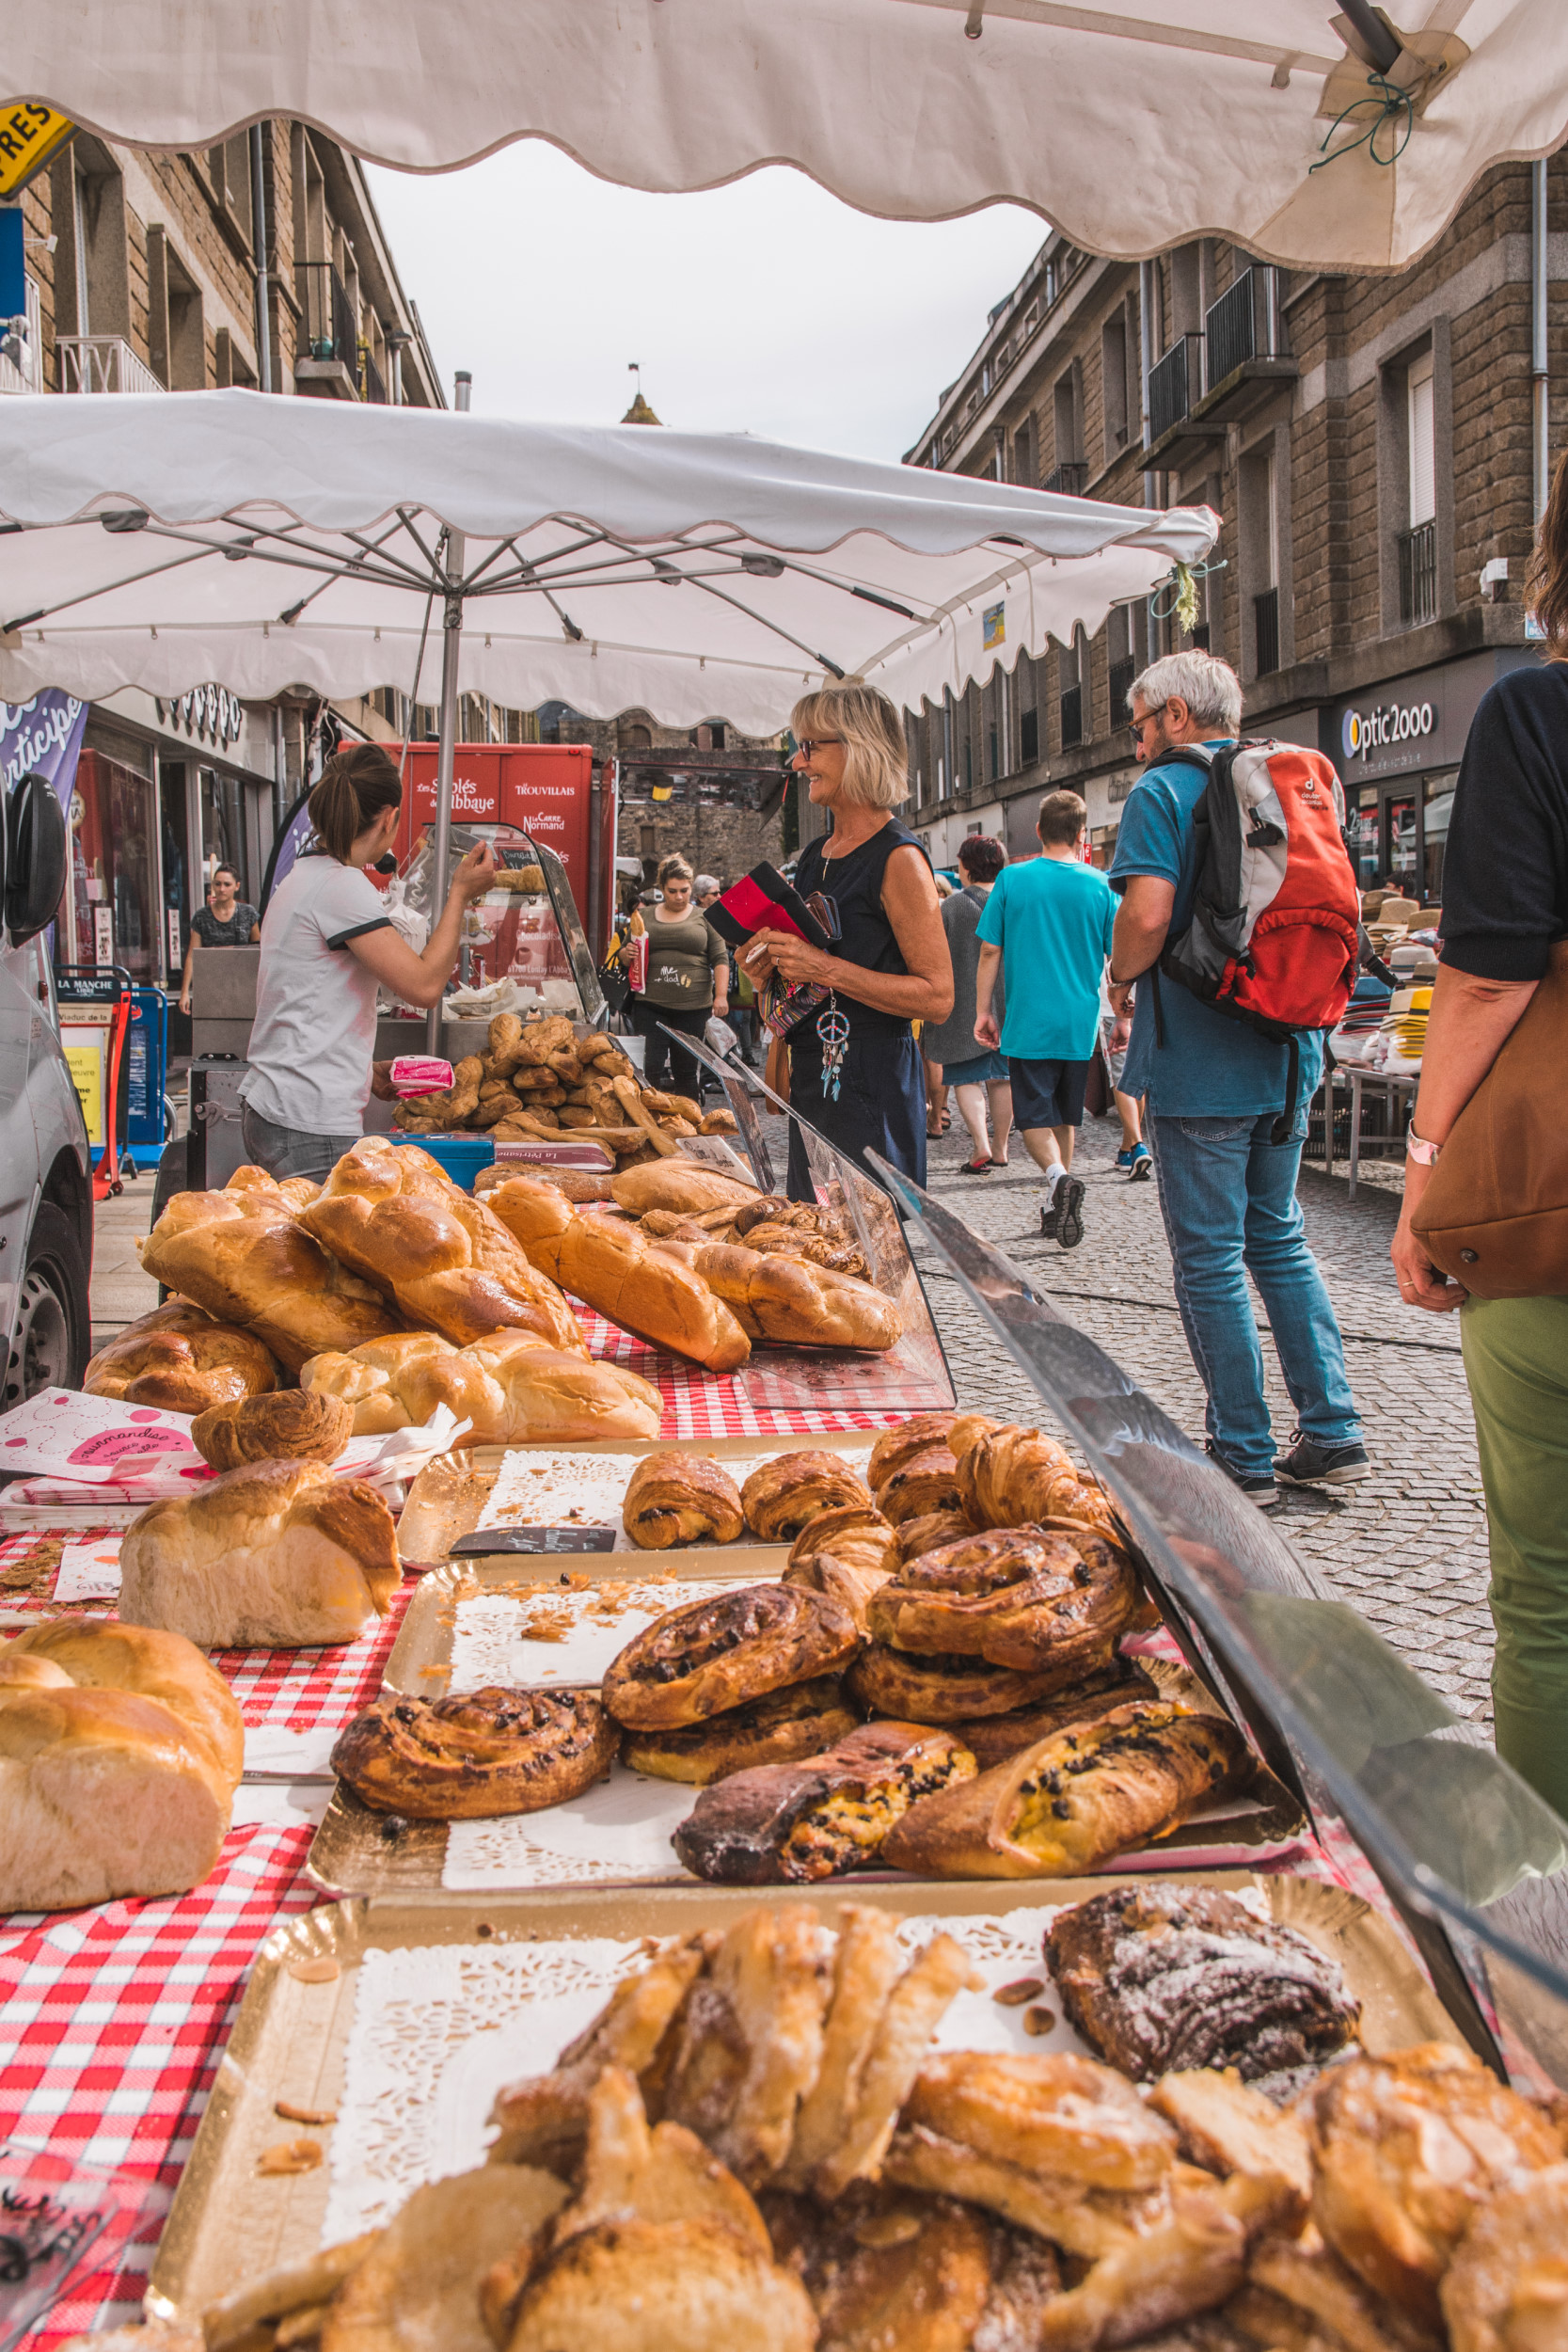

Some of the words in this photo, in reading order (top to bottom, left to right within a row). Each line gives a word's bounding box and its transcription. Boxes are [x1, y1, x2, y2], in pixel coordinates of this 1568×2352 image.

[430, 777, 477, 794] Sblés
[515, 786, 576, 796] TROUVILLAIS
[523, 816, 564, 834] Normand
[57, 979, 71, 989] LA
[73, 979, 114, 990] MANCHE
